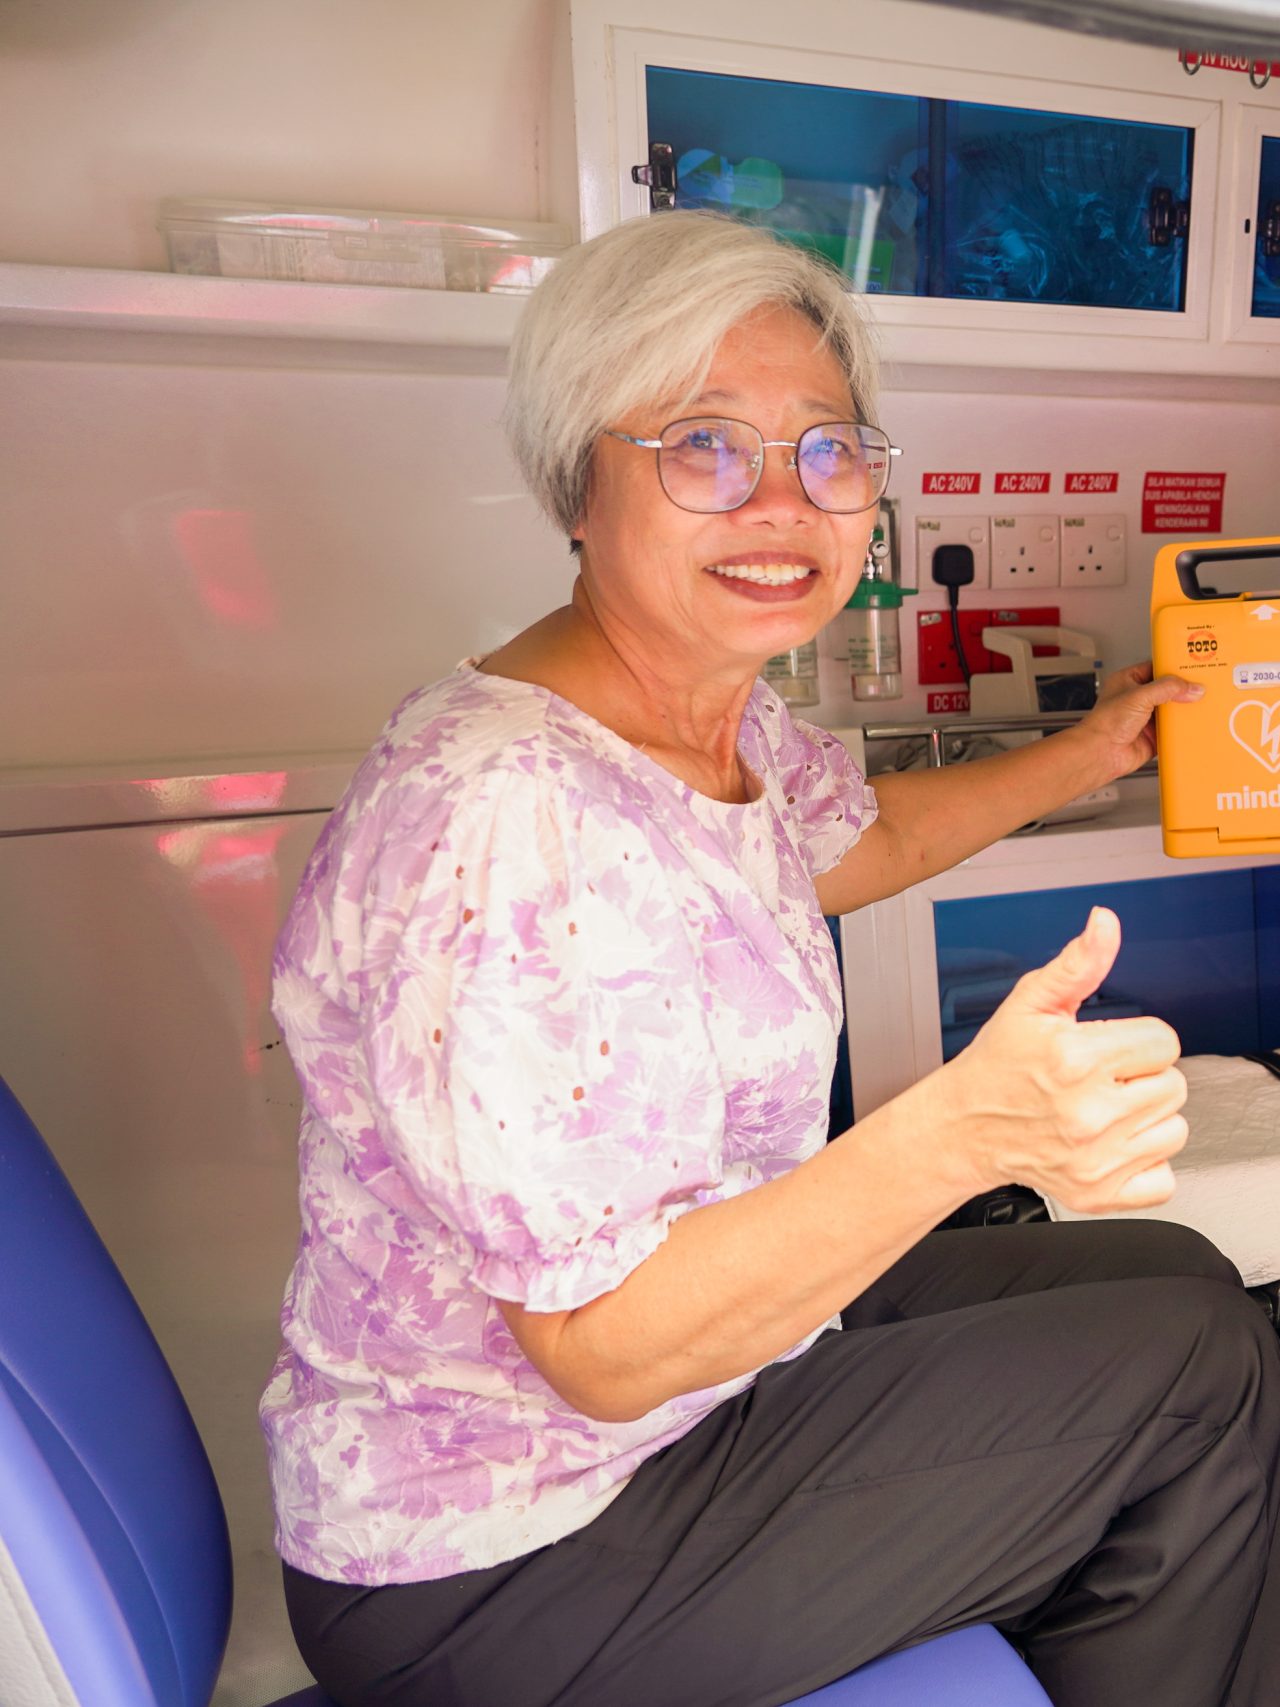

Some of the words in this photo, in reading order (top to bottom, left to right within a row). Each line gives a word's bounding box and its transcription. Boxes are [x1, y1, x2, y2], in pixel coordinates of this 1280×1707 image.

[1205, 49, 1216, 65] IV
[1220, 53, 1257, 71] HOO
[929, 475, 946, 492] AC
[947, 475, 975, 492] 240V
[1000, 475, 1017, 491] AC
[1018, 475, 1045, 491] 240V
[1070, 475, 1087, 491] AC
[1087, 475, 1114, 491] 240V
[1187, 639, 1218, 653] TOTO
[933, 695, 949, 711] DC
